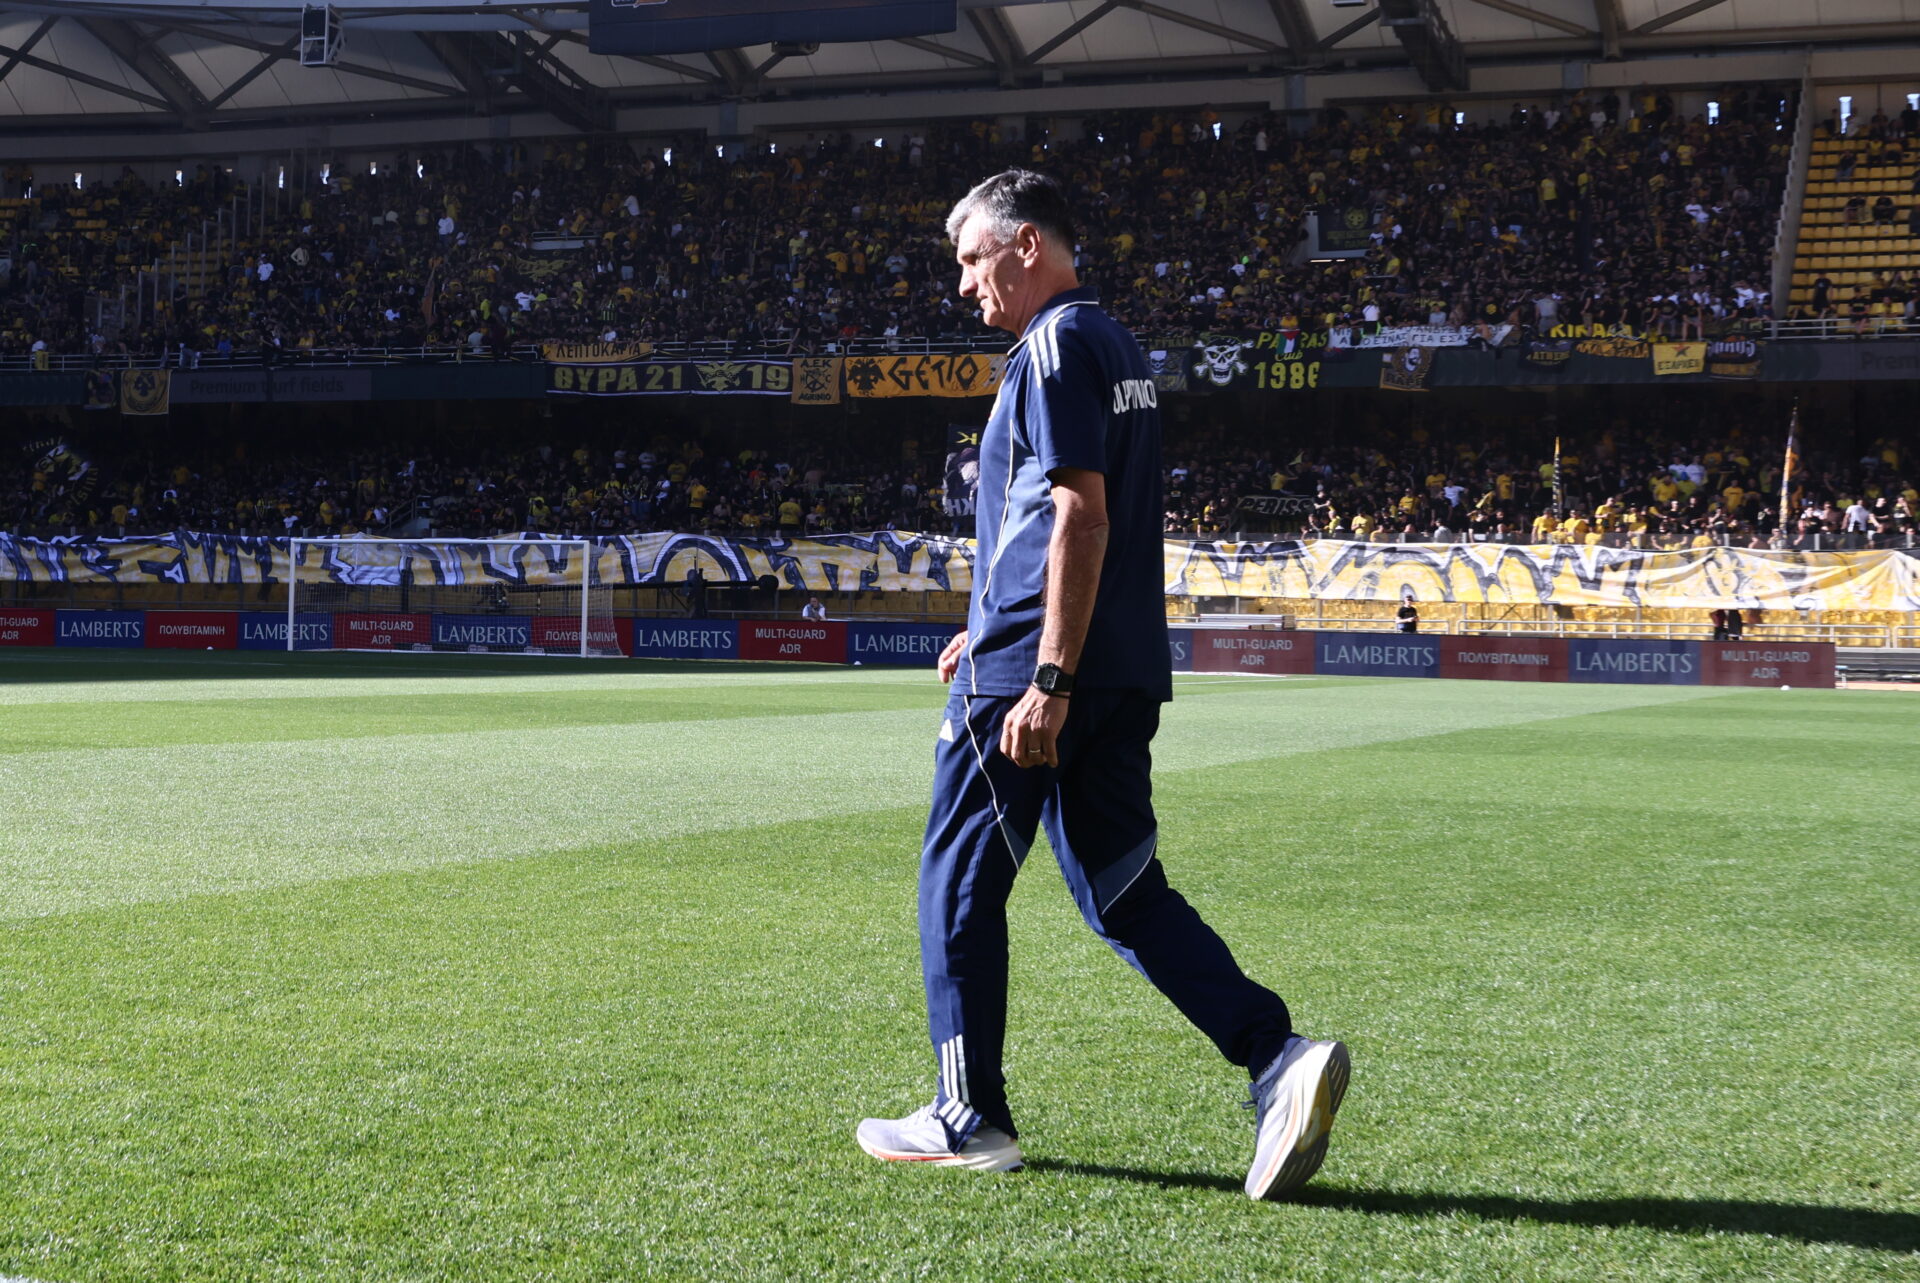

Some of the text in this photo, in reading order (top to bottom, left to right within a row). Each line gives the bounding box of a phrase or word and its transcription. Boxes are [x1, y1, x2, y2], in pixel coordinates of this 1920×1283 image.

[1255, 331, 1328, 349] PARAS
[645, 364, 682, 390] 21
[191, 378, 256, 394] Premium
[300, 376, 345, 393] fields
[61, 620, 140, 638] LAMBERTS
[159, 624, 225, 636] ΠΟΛΥΒΙΤΑΜΙΝΗ
[244, 623, 328, 641] LAMBERTS
[350, 620, 414, 631] MULTI-GUARD
[1, 630, 19, 640] ADR
[371, 634, 392, 645] ADR
[439, 625, 527, 644] LAMBERTS
[545, 630, 618, 642] ΠΟΛΥΒΙΑΜΙΝΗ
[639, 629, 732, 649] LAMBERTS
[755, 628, 826, 640] MULTI-GUARD
[779, 643, 801, 654] ADR
[1213, 638, 1293, 651] MULTI-GUARD
[1240, 653, 1265, 666] ADR
[1324, 644, 1435, 667] LAMBERTS
[1458, 651, 1549, 666] ΠΟΛΥΒΙΤΑΜΙΝΗ
[1576, 651, 1693, 673] LAMBERTS
[1721, 649, 1811, 664] MULTI-GUARD
[1751, 666, 1780, 679] ADR
